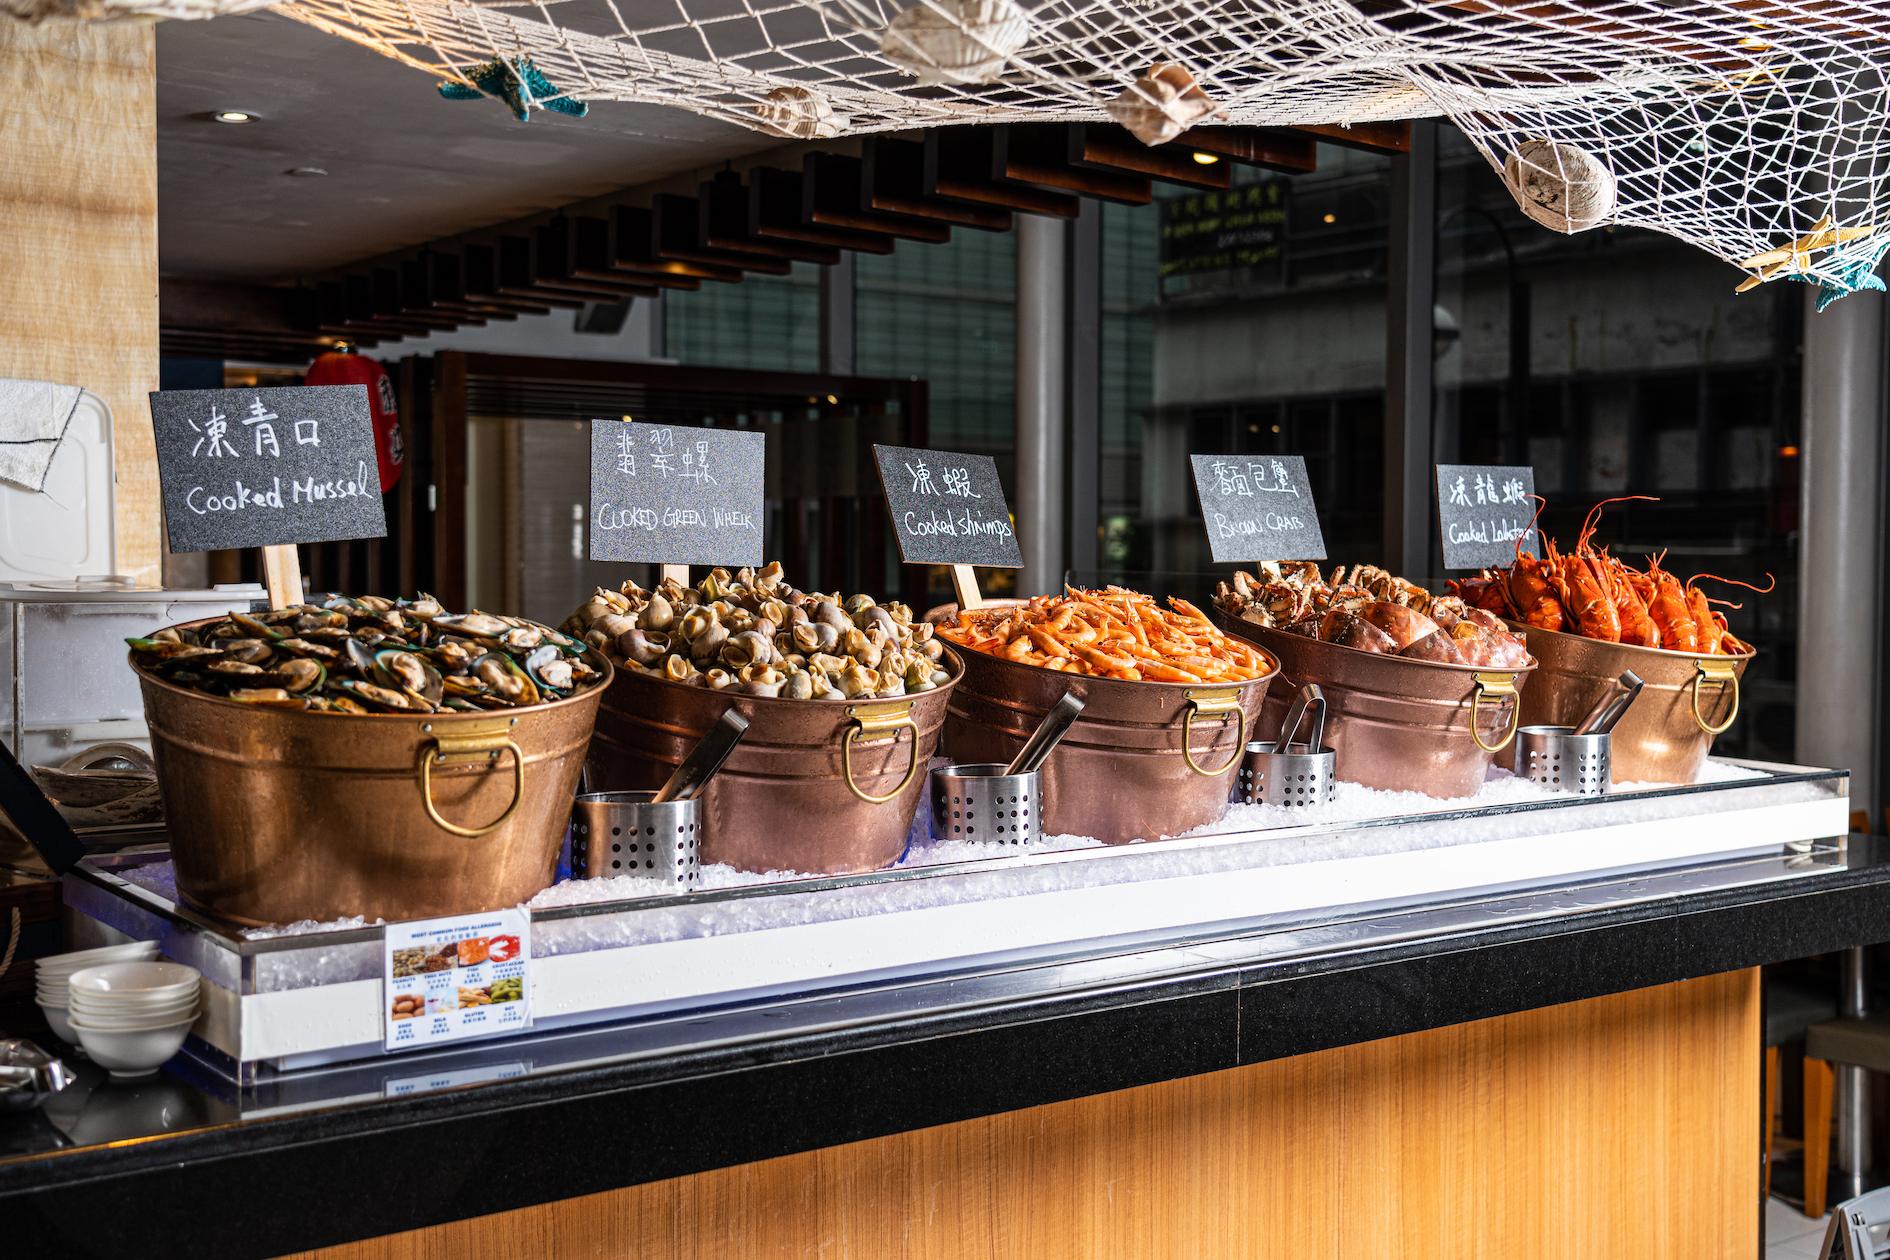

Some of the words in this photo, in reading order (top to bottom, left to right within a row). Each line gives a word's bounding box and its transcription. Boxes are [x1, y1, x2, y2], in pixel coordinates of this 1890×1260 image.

[188, 397, 321, 458] 凍青口
[186, 476, 285, 514] Cooked
[292, 460, 373, 503] Mussel
[905, 458, 982, 499] 凍蝦
[663, 507, 706, 528] GREEN
[904, 509, 958, 537] Cooked
[1448, 520, 1490, 544] Cooked
